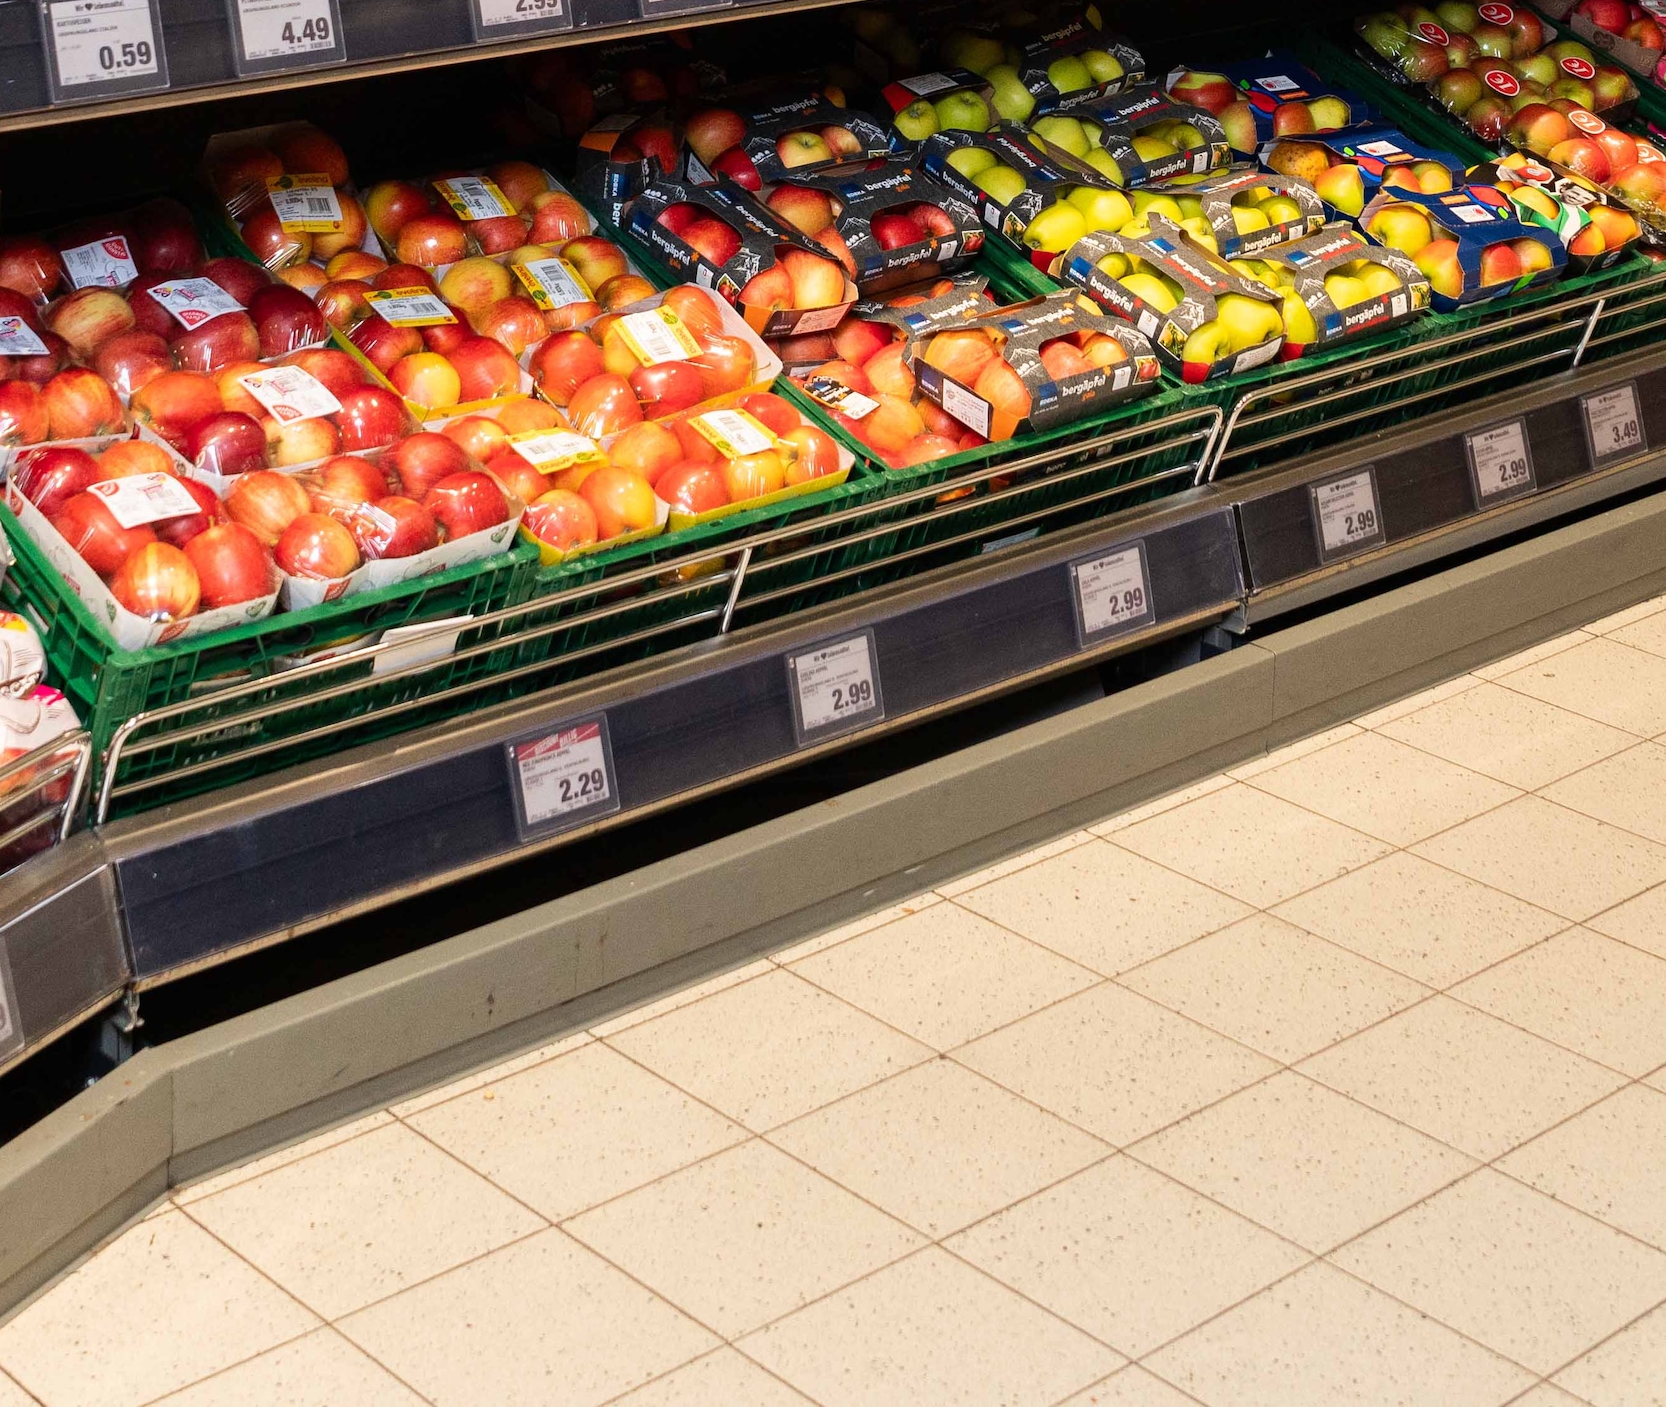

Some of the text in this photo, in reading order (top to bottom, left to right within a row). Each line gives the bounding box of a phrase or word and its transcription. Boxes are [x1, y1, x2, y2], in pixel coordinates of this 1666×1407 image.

[282, 17, 330, 44] 4.49
[1042, 23, 1083, 42] bergäpfel
[99, 41, 152, 70] 0.59
[771, 98, 819, 119] bergäpfel
[1059, 89, 1099, 107] bergäpfel
[1119, 97, 1160, 116] bergäpfel
[1149, 159, 1187, 178] bergäpfel
[865, 173, 913, 193] bergäpfel
[942, 171, 979, 205] bergäpfel
[631, 222, 649, 237] EDEKA
[735, 204, 778, 238] bergäpfel
[651, 201, 691, 266] bergäpfel
[1244, 231, 1282, 252] bergäpfel
[887, 247, 933, 269] bergäpfel
[1309, 237, 1351, 257] bergäpfel
[1171, 254, 1217, 287] bergäpfel
[1090, 275, 1135, 312] bergäpfel
[930, 297, 980, 320] bergäpfel
[1026, 307, 1075, 326] bergäpfel
[1345, 303, 1385, 326] bergäpfel
[1061, 374, 1106, 398] bergäpfel
[1613, 420, 1638, 444] 3.49
[1499, 458, 1527, 482] 2.99
[1345, 509, 1374, 536] 2.99
[1109, 587, 1143, 616] 2.99
[831, 679, 871, 710] 2.99
[559, 768, 604, 804] 2.29
